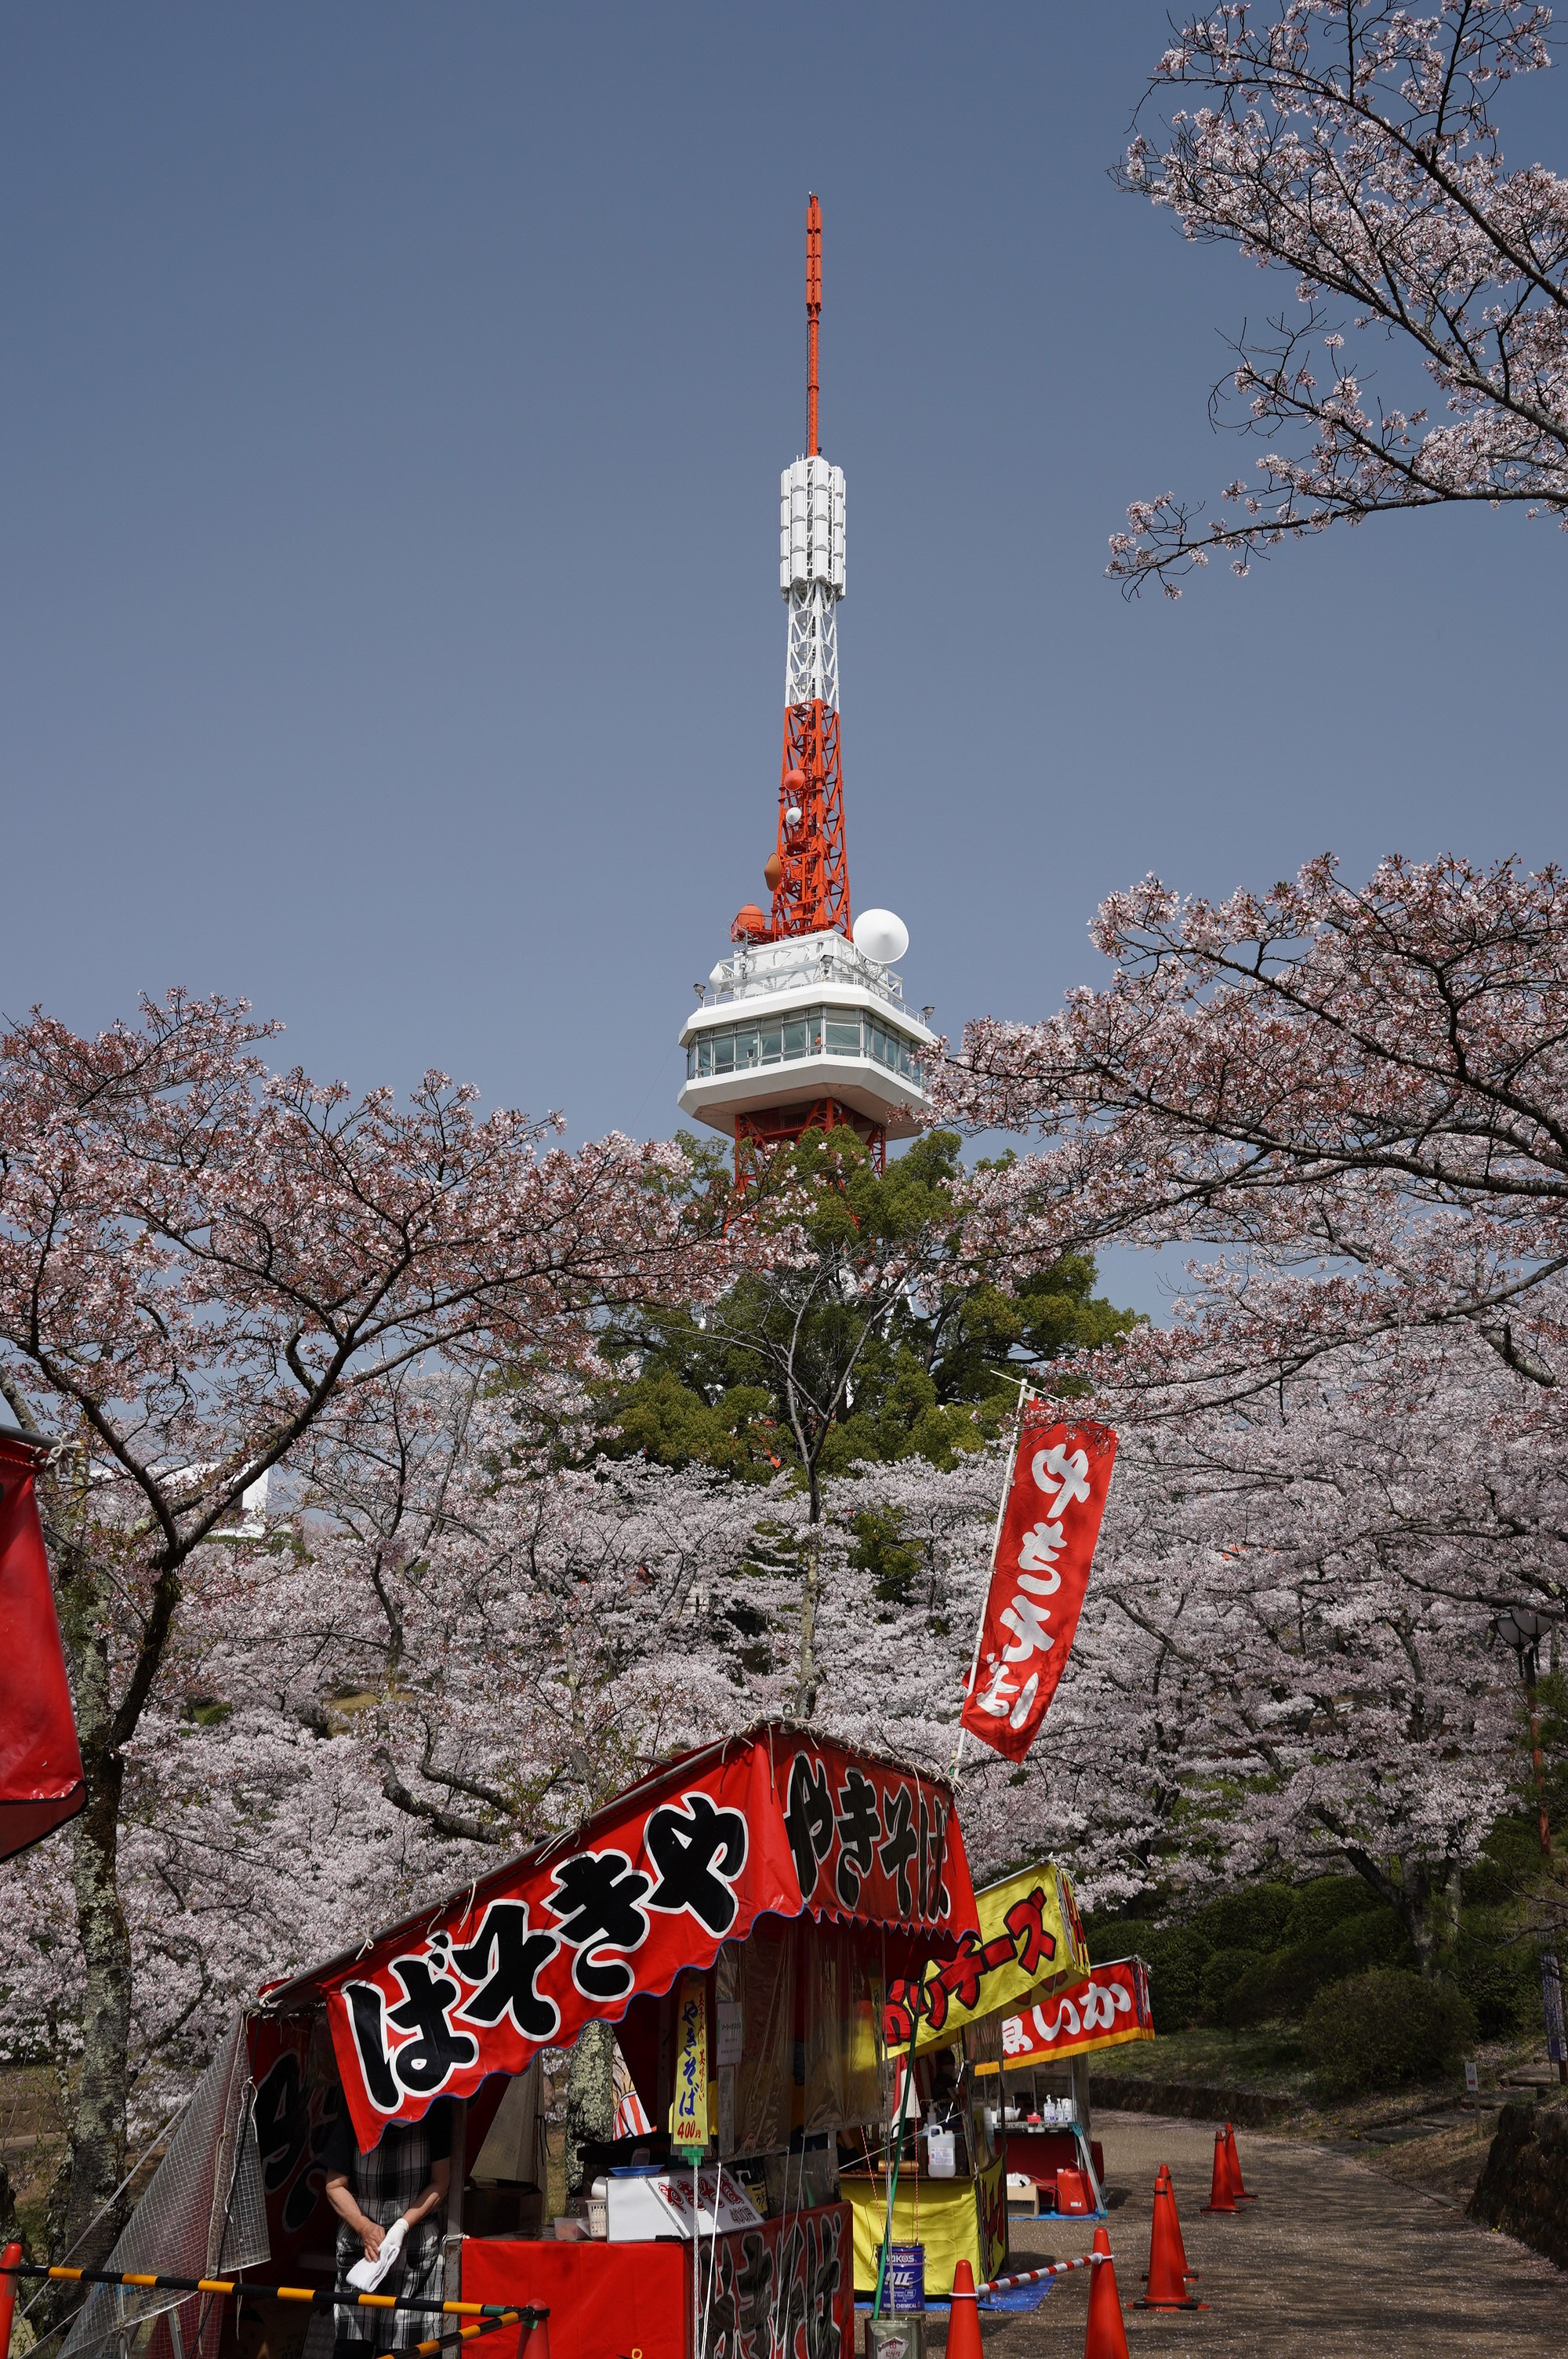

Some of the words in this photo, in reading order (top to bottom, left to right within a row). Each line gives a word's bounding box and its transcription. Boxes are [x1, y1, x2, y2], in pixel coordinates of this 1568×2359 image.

[783, 1750, 951, 1924] やきそば
[679, 2001, 699, 2117] やきそば
[677, 2120, 702, 2139] 400円
[658, 2172, 745, 2215] やきそば
[729, 2205, 757, 2225] 400円
